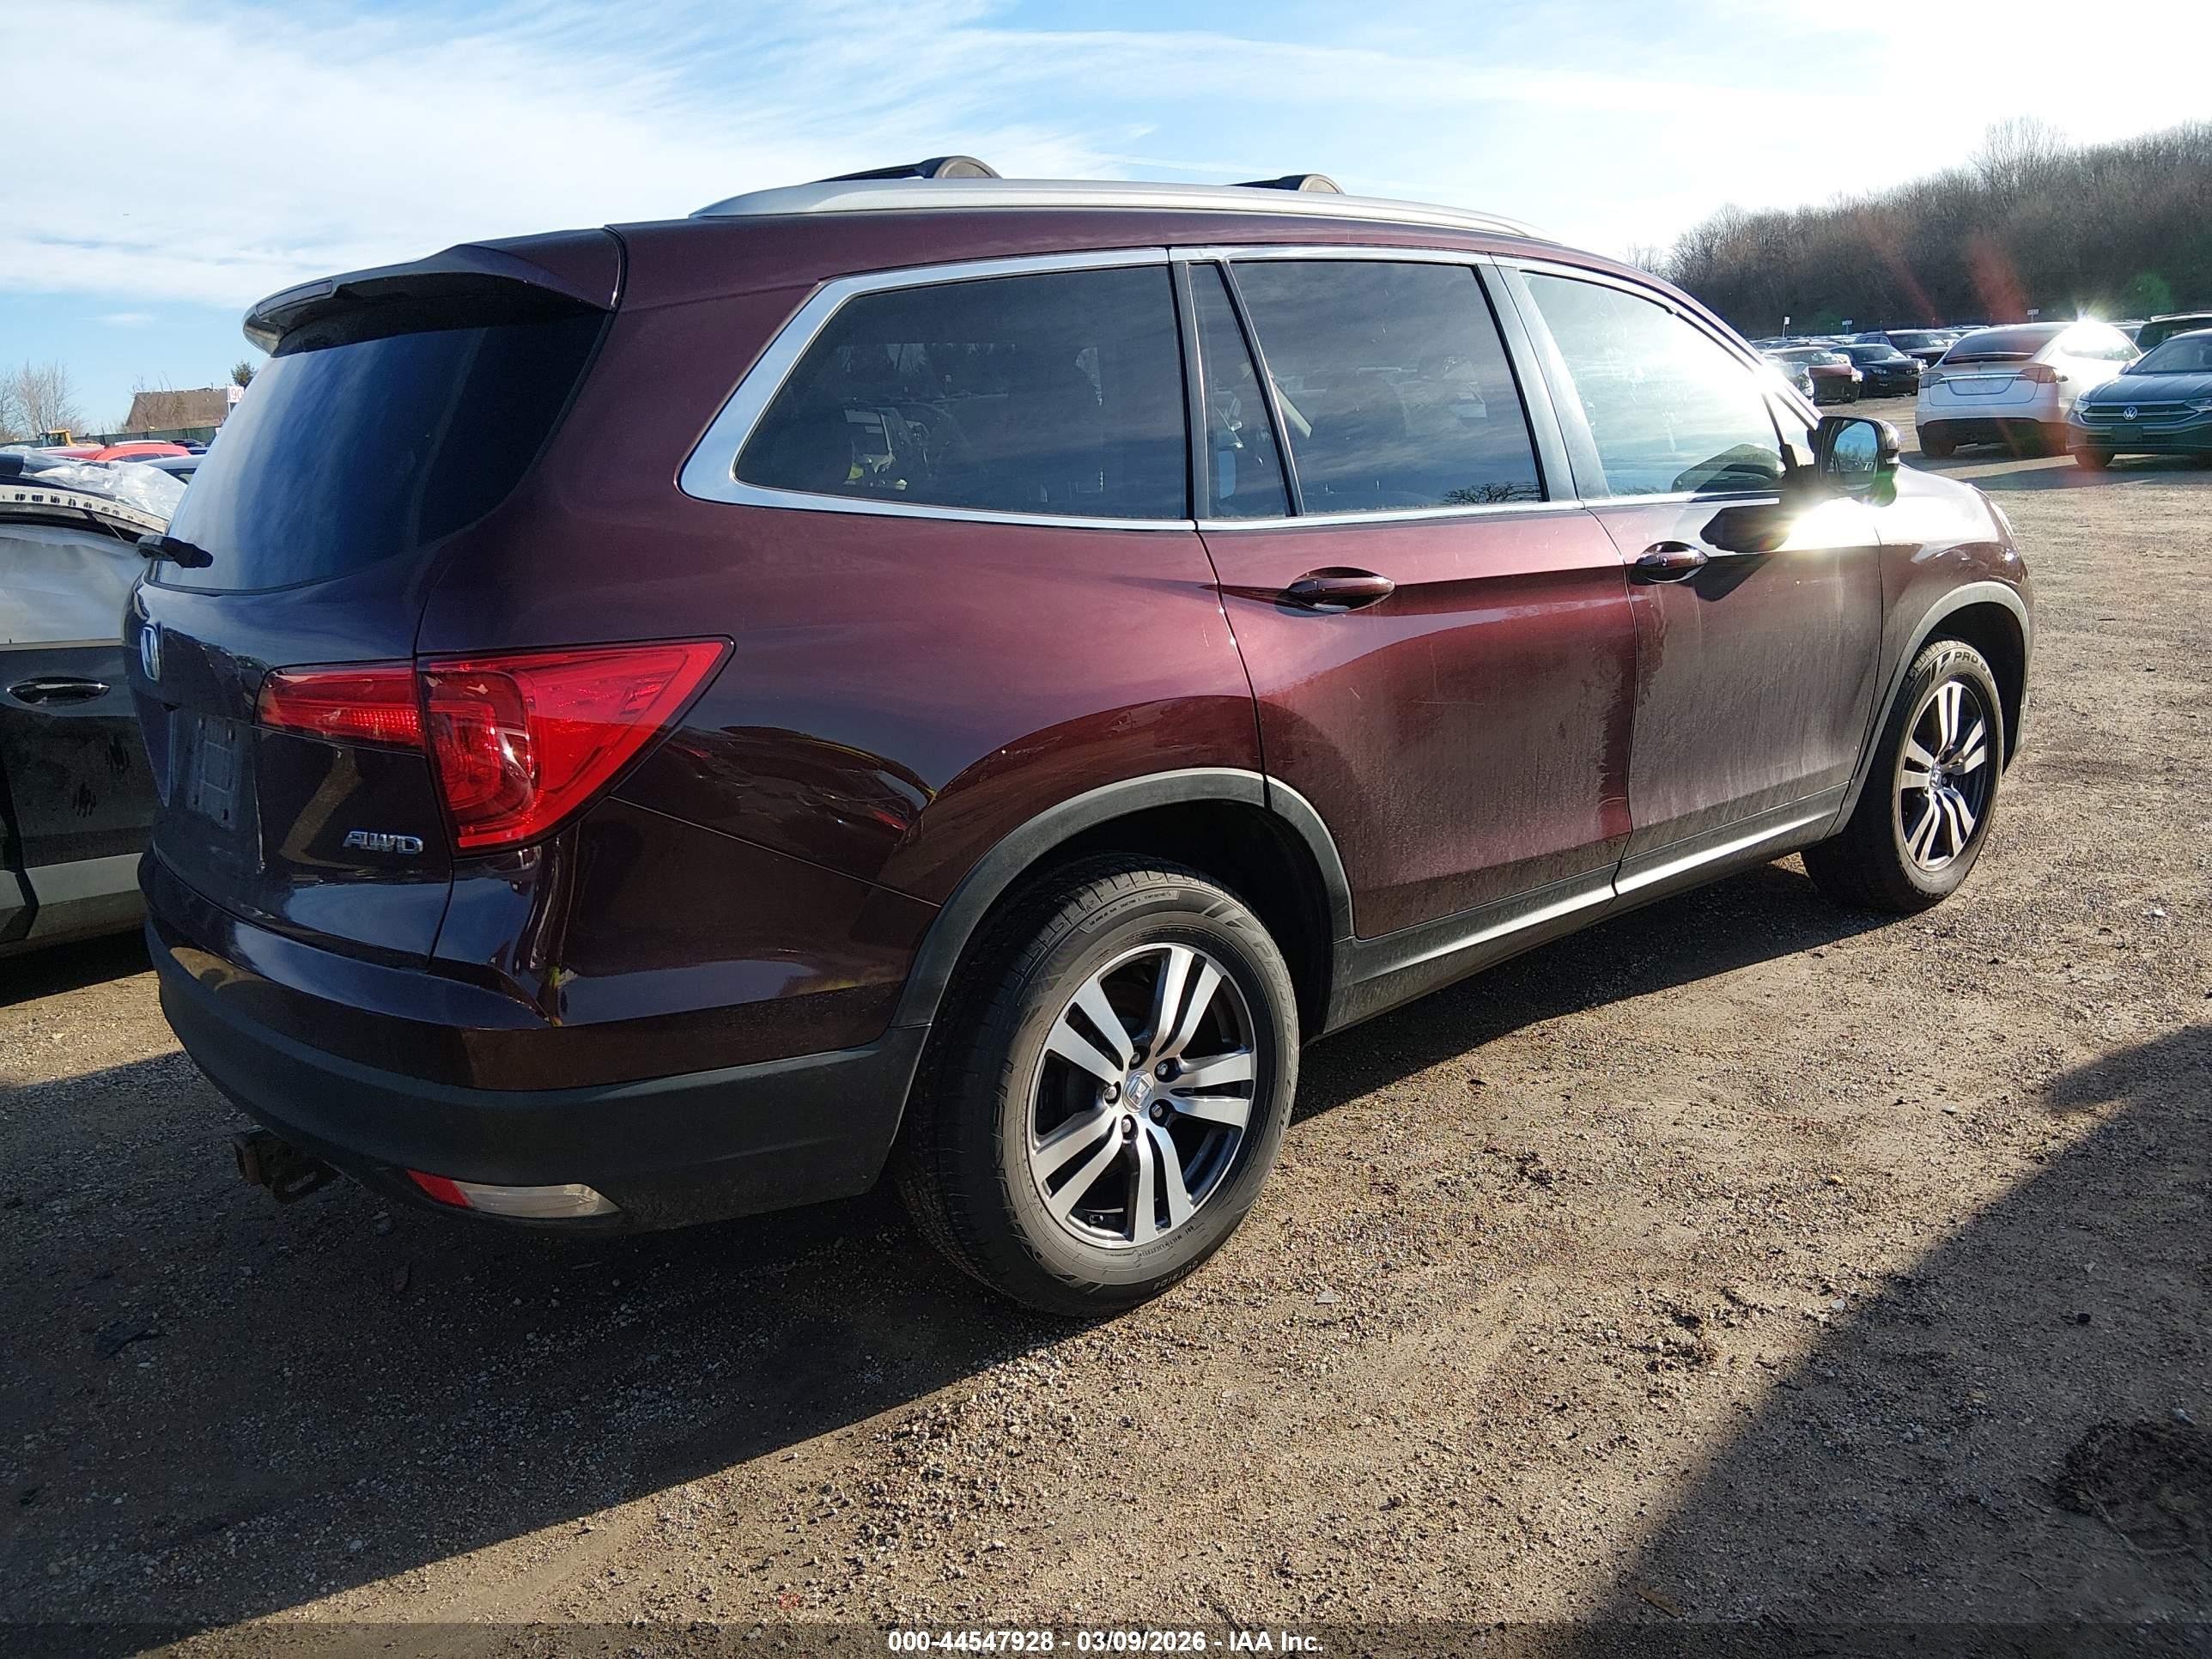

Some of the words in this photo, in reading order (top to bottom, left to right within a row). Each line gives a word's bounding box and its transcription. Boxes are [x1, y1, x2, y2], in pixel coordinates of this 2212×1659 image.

[1953, 651, 1978, 664] PRO
[343, 830, 423, 854] AWD
[1252, 938, 1295, 1015] PRO
[1153, 1260, 1199, 1290] OUTSIDE
